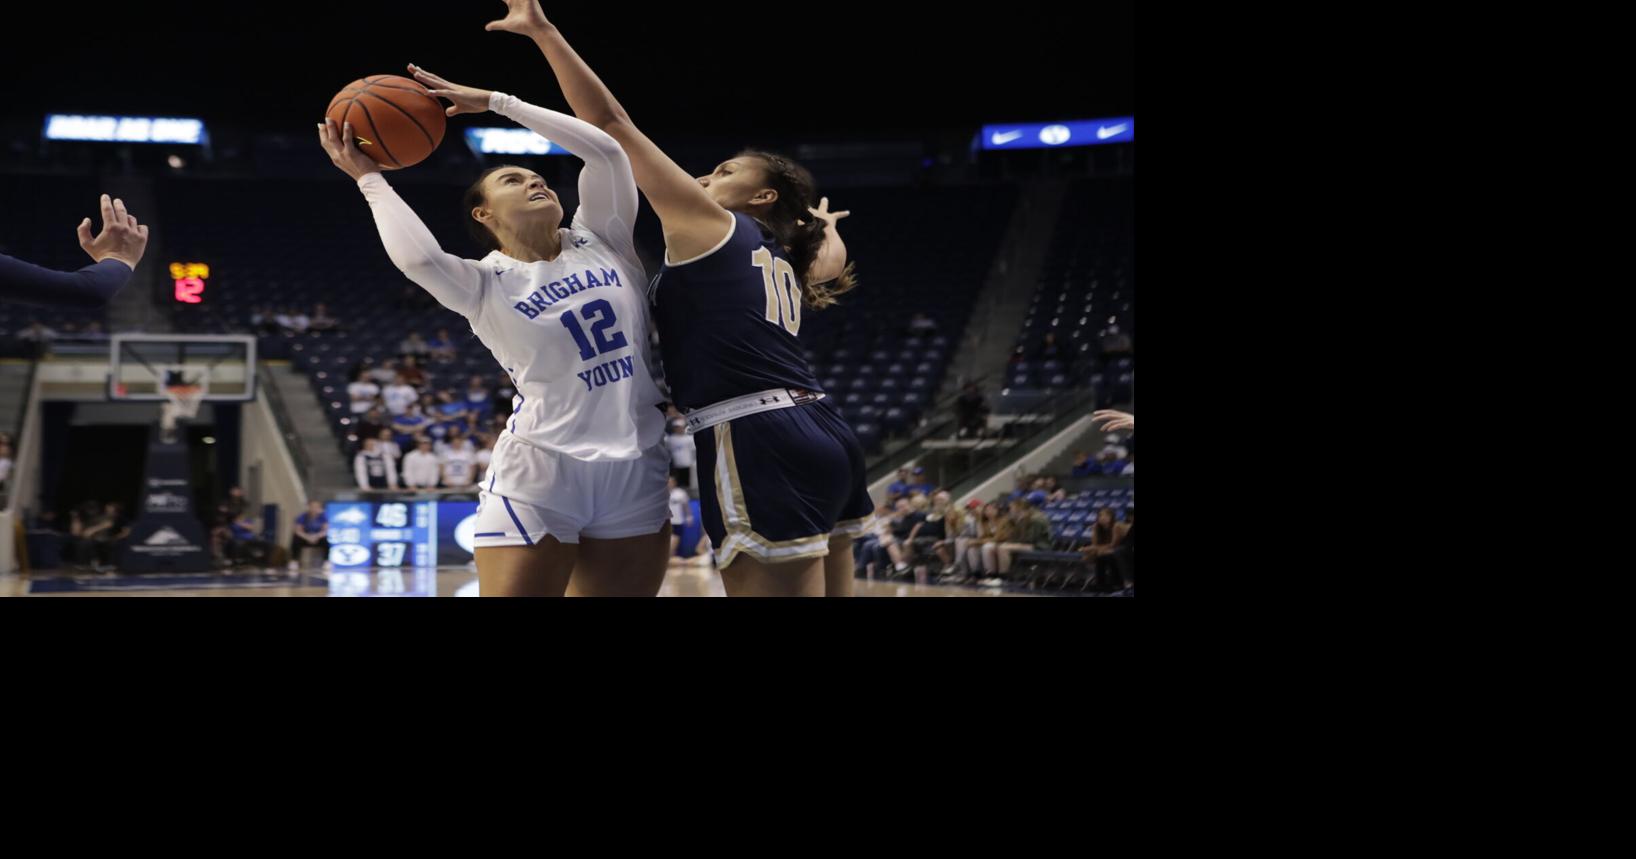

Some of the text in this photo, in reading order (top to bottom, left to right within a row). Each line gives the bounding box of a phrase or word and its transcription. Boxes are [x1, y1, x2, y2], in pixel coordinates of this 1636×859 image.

[513, 267, 622, 320] BRIGHAM
[752, 244, 801, 336] 10
[560, 299, 628, 361] 12
[577, 355, 634, 392] YOUN
[377, 542, 406, 567] 37
